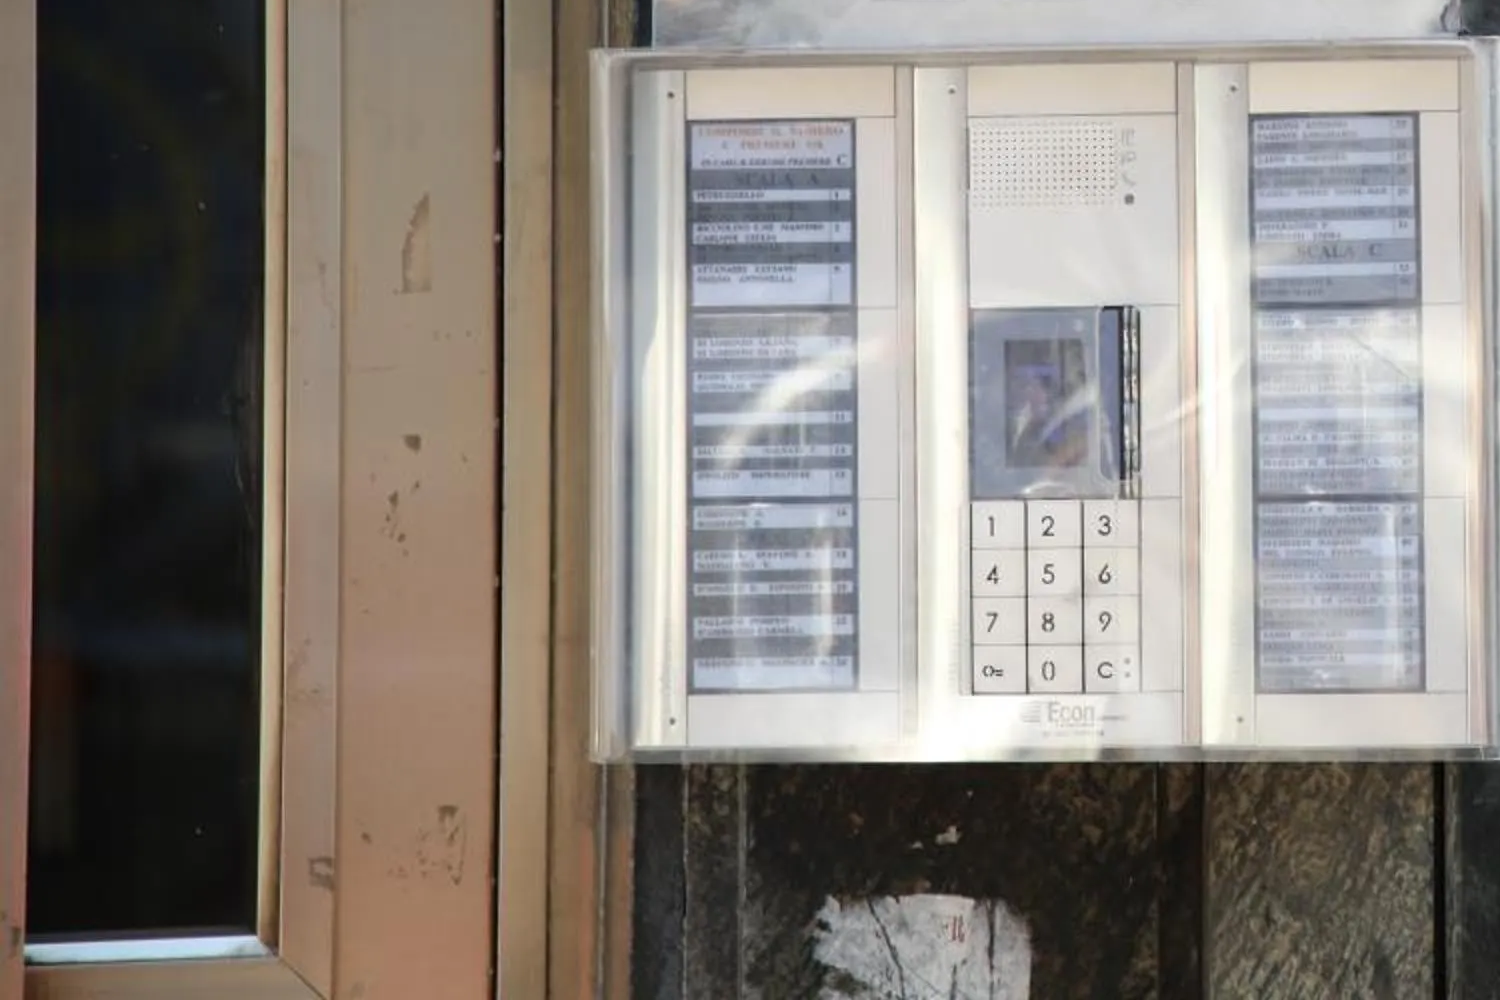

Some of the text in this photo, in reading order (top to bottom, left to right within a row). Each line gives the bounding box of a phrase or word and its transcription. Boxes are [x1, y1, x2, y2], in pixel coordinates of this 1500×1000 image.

[988, 515, 1112, 537] 1 2 3
[986, 563, 1112, 585] 4 5 6
[986, 611, 1112, 633] 7 8 9
[1041, 660, 1113, 681] 0 C
